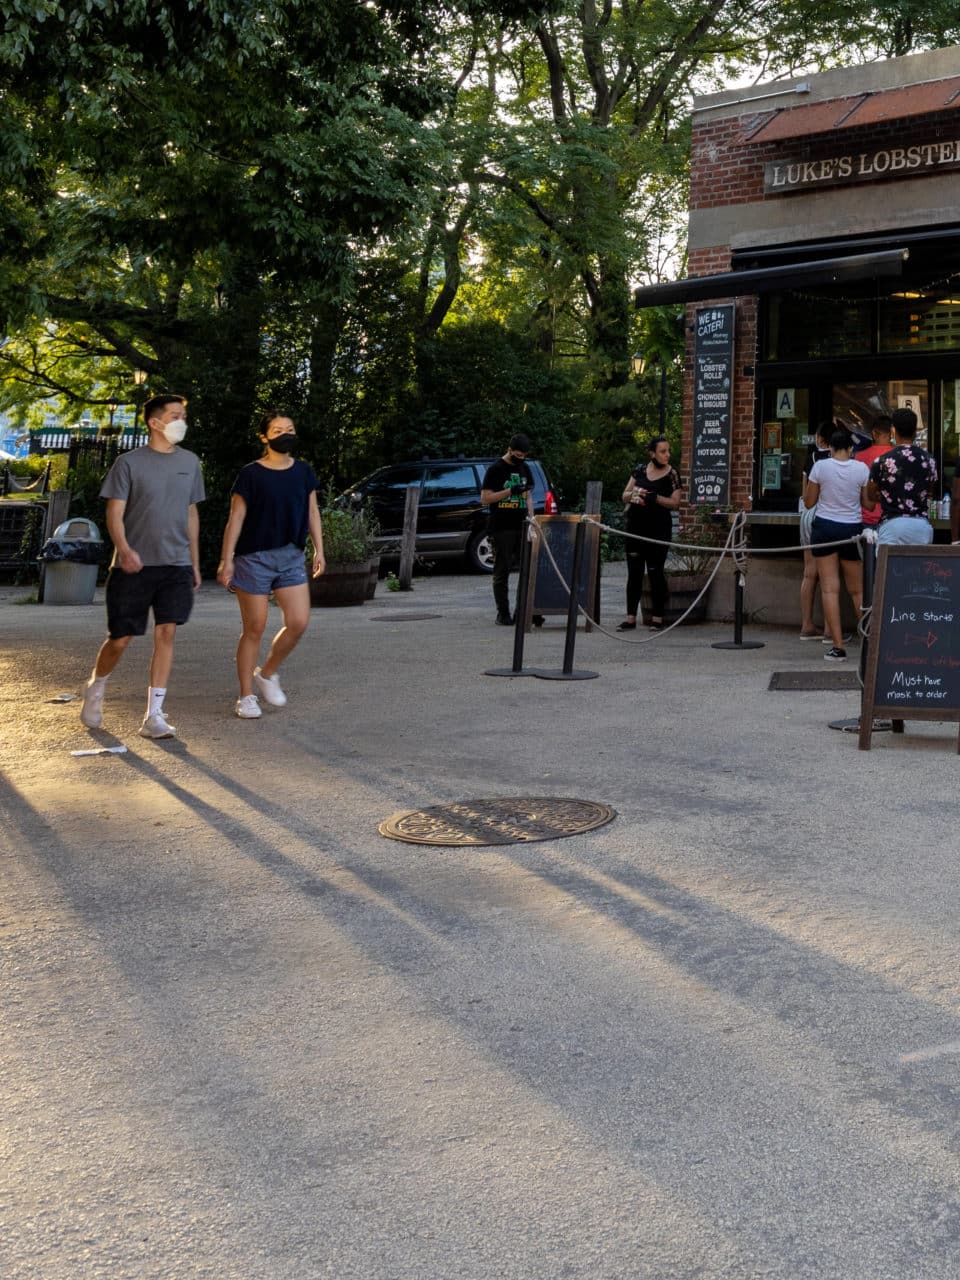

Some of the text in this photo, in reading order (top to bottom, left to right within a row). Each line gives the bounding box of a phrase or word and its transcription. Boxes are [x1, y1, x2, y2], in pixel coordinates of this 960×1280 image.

[772, 156, 852, 187] LUKE'S
[698, 312, 710, 326] WE
[700, 363, 727, 372] LOBSTER
[703, 371, 723, 380] ROLLS
[697, 393, 729, 401] CHOWDERS
[780, 391, 791, 410] A
[697, 448, 726, 456] HOT DOGS
[890, 606, 916, 623] Line
[891, 671, 922, 687] Must
[887, 690, 912, 699] mask
[926, 690, 948, 698] order
